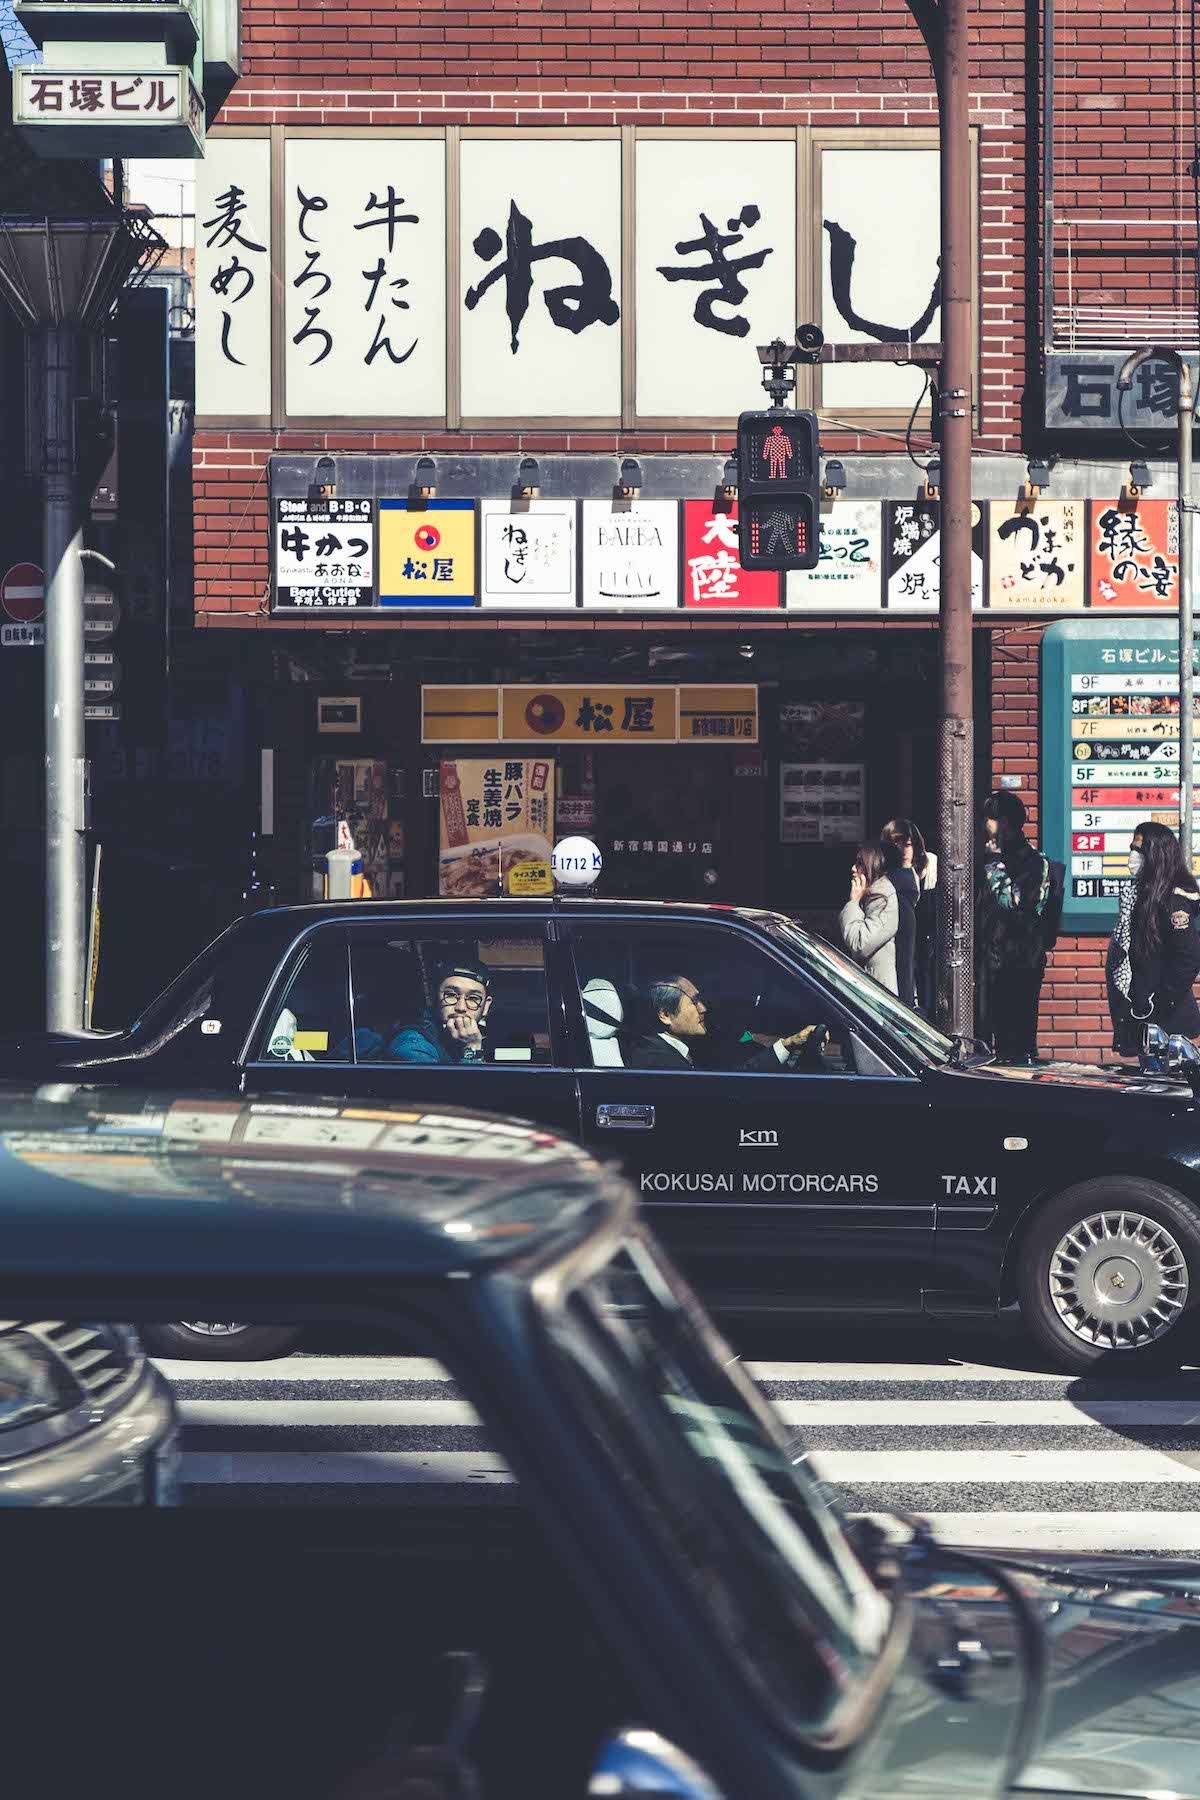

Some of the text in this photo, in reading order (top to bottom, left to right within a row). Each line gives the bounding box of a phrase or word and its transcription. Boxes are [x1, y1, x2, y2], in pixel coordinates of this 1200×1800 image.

[29, 77, 176, 112] 石塚ビル
[203, 185, 267, 366] 麦めし
[293, 185, 333, 366] とろろ
[353, 185, 419, 365] 牛たん
[279, 500, 308, 513] Steak
[310, 502, 327, 513] and
[598, 527, 662, 546] BARBA
[893, 505, 920, 556] 炉端焼
[281, 525, 369, 562] 牛かつ
[501, 523, 528, 584] ねぎし
[314, 563, 362, 578] あおな
[402, 557, 454, 581] 松屋
[289, 586, 361, 598] Beef Cutlet
[1081, 676, 1099, 689] 9F
[1071, 699, 1088, 714] 8F
[575, 696, 656, 734] 松屋
[1080, 722, 1098, 735] 7F
[1076, 747, 1089, 756] 6F
[1076, 768, 1096, 781] 5F
[483, 768, 503, 828] 生姜焼
[504, 761, 523, 822] 豚バラ
[1080, 790, 1099, 803] 4F
[466, 798, 480, 827] 定食
[1084, 813, 1101, 827] 3F
[613, 840, 713, 854] 新宿靖国通り店
[1077, 836, 1101, 850] 2F
[561, 857, 587, 870] 1712
[1081, 860, 1095, 871] 1F
[1077, 880, 1094, 896] B1
[740, 1129, 778, 1143] km
[640, 1173, 997, 1196] KOKUSAI MOTORCARS TAXI
